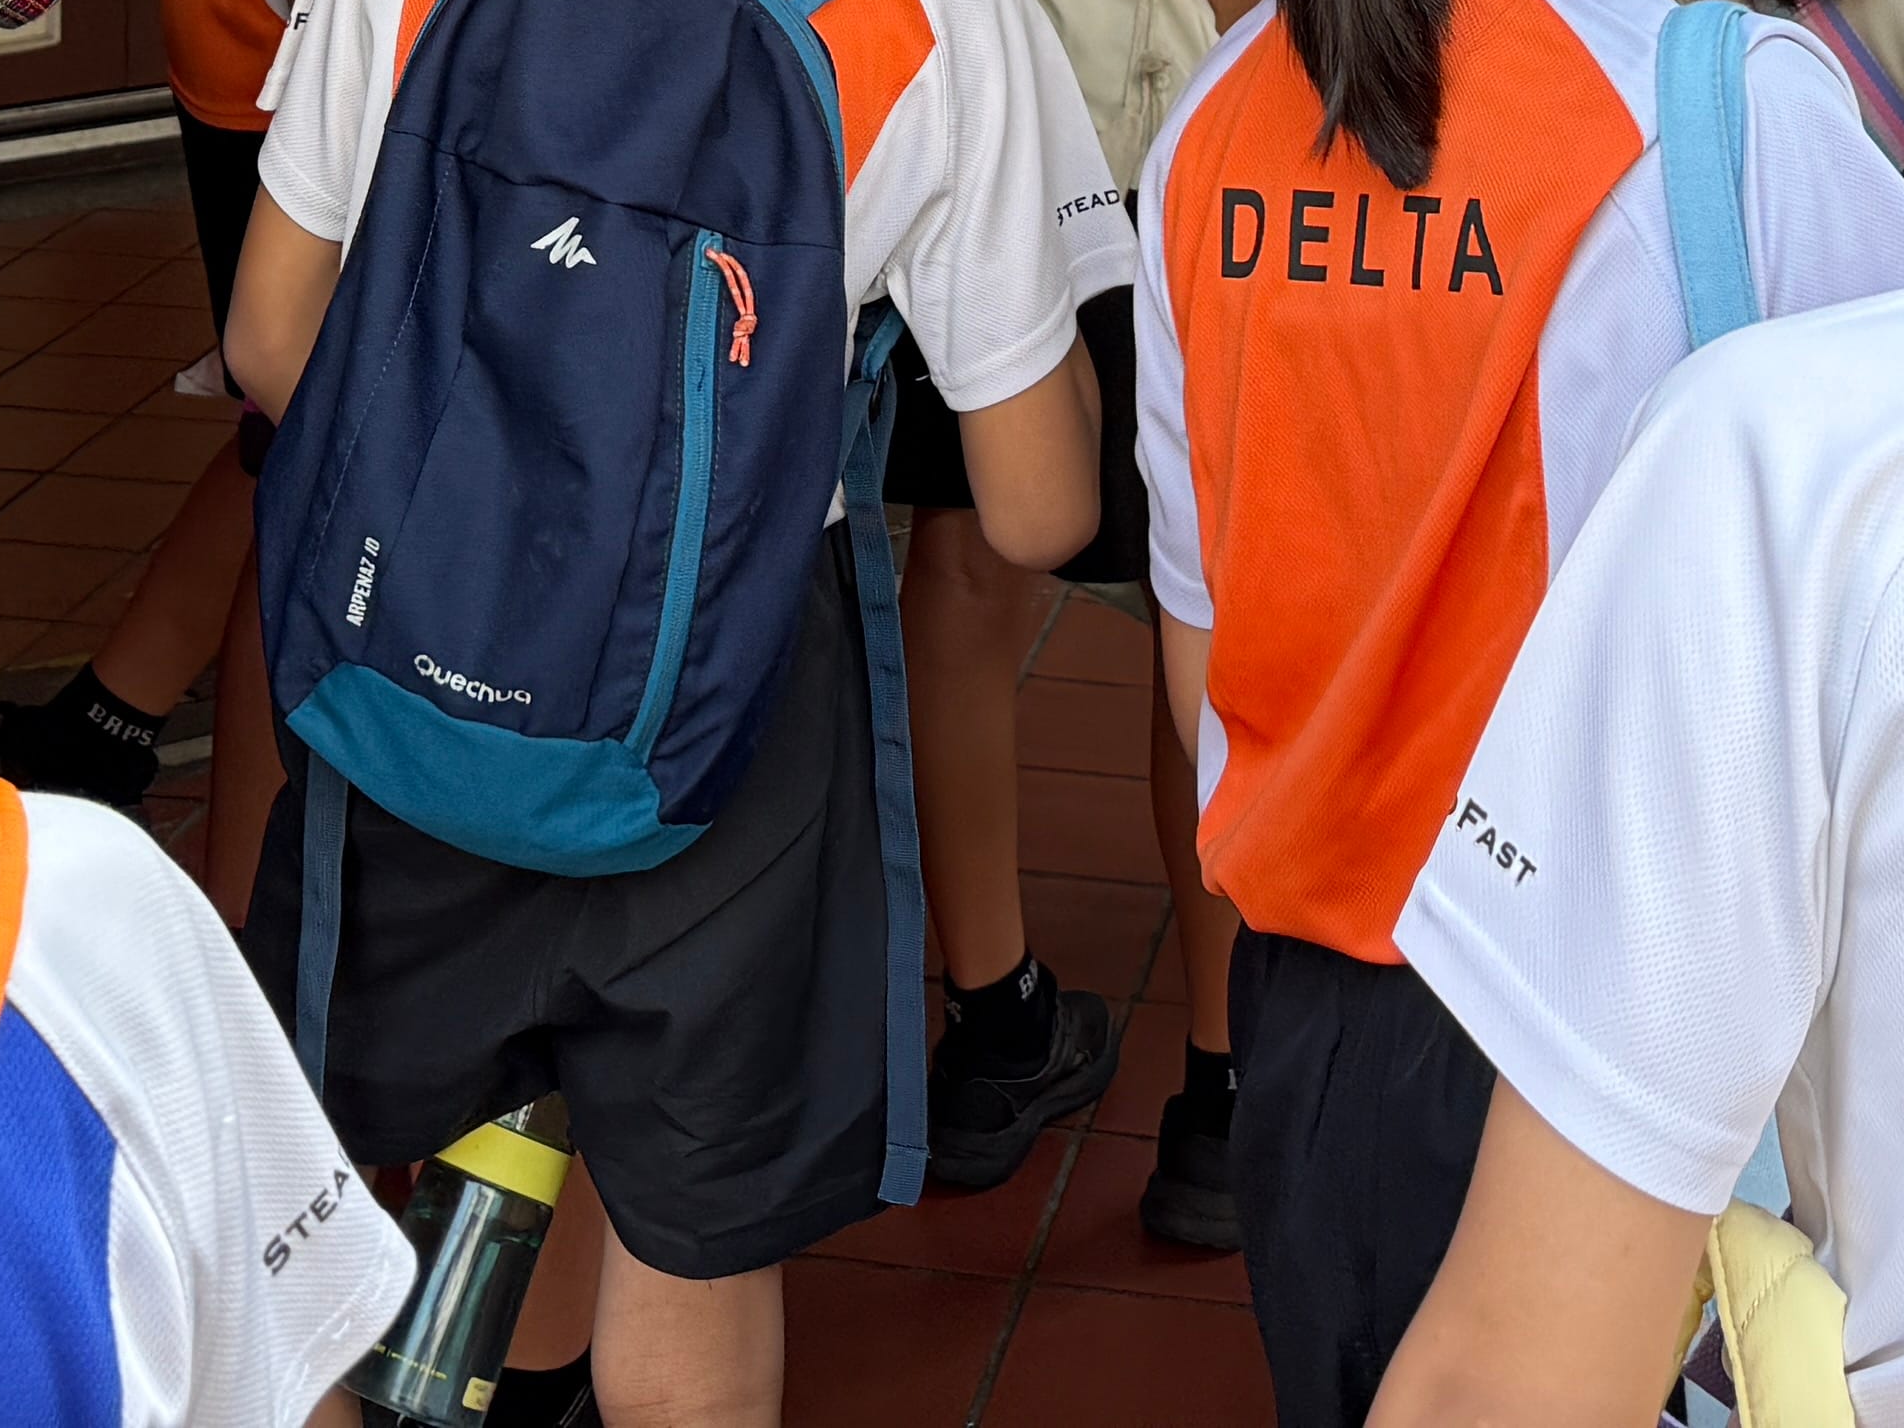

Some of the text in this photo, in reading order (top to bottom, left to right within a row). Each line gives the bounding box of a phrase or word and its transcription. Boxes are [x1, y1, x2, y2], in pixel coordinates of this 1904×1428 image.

[1220, 187, 1505, 296] DELTA
[346, 557, 375, 627] ARPENAZ
[412, 654, 533, 708] Quechua
